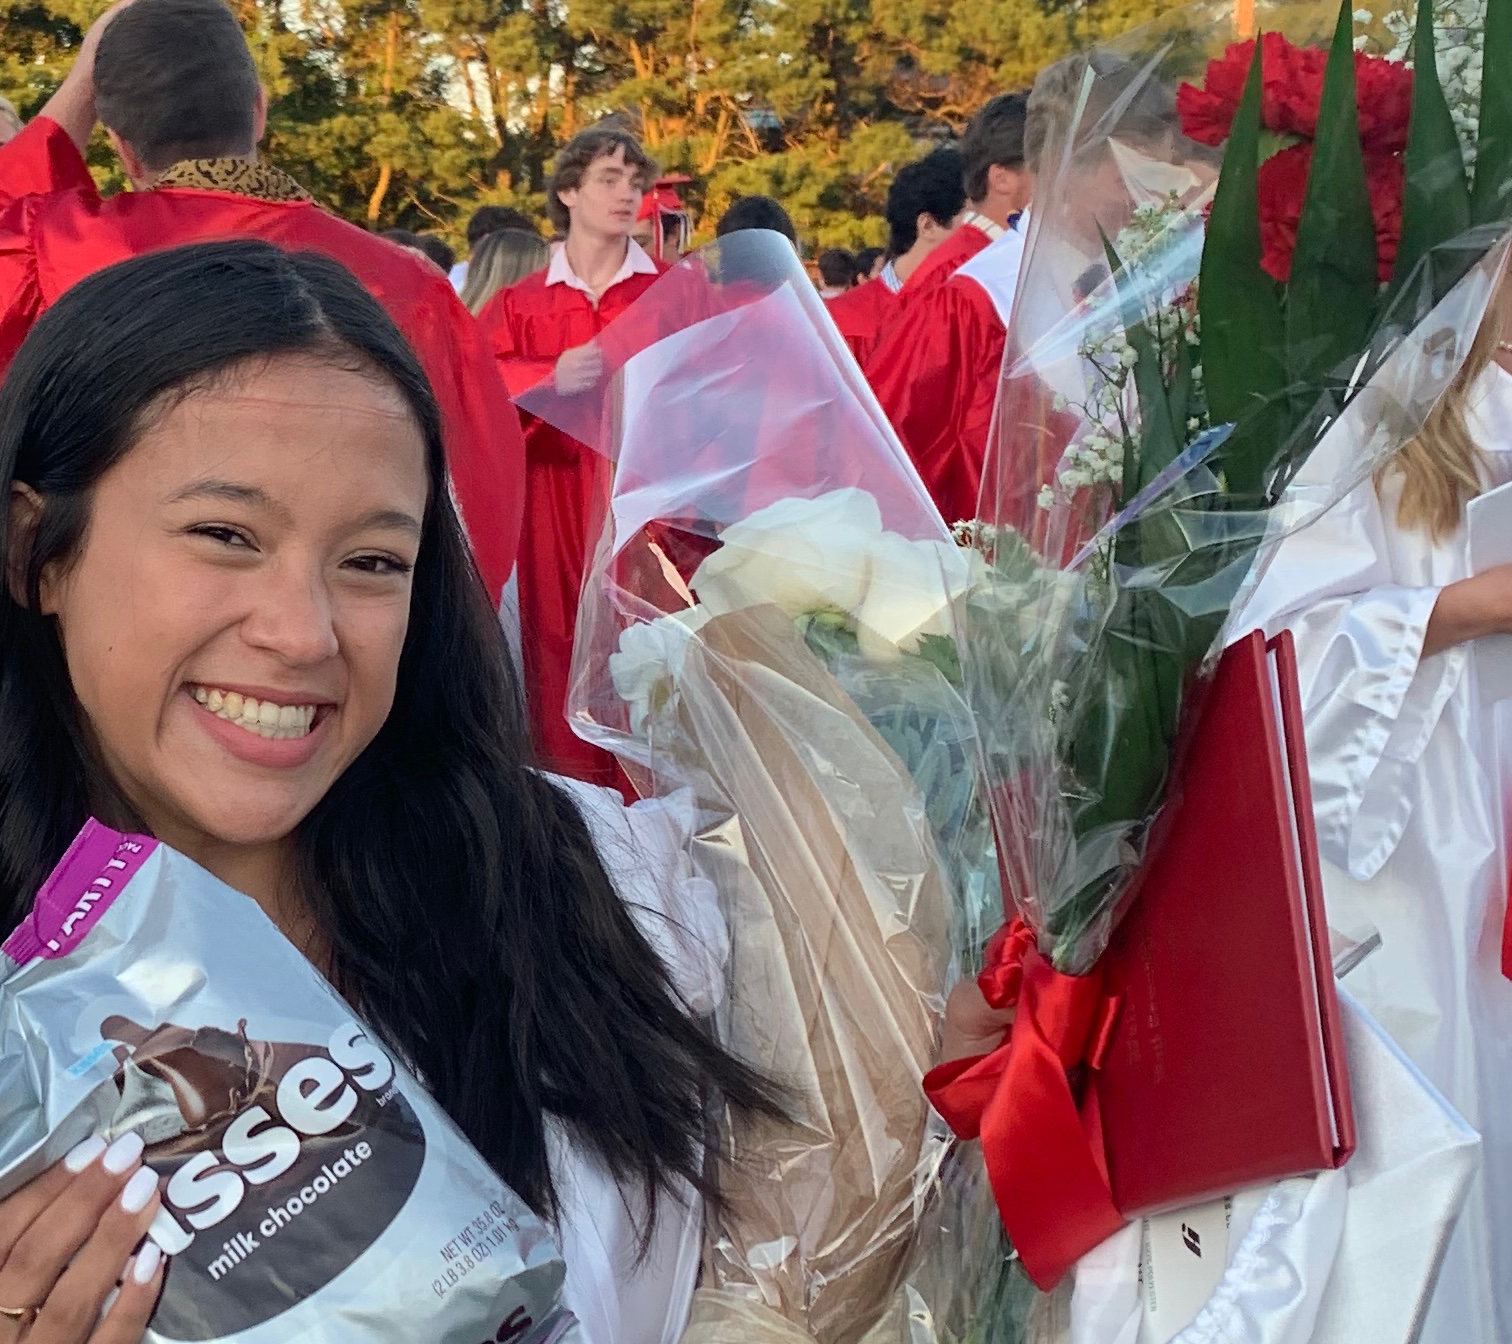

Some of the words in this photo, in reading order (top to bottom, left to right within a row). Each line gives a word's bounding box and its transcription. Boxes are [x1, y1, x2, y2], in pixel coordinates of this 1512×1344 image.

[148, 1022, 393, 1256] isses
[207, 1231, 260, 1281] milk
[259, 1141, 373, 1238] chocolate
[431, 1279, 446, 1299] (2
[441, 1267, 459, 1287] LB
[455, 1255, 475, 1277] 3.8
[471, 1242, 492, 1262] OZ)
[486, 1226, 508, 1247] 1.01
[501, 1217, 520, 1233] kg
[440, 1238, 463, 1263] NET
[457, 1226, 476, 1247] WT
[472, 1211, 494, 1235] 35.8
[489, 1200, 505, 1218] OZ
